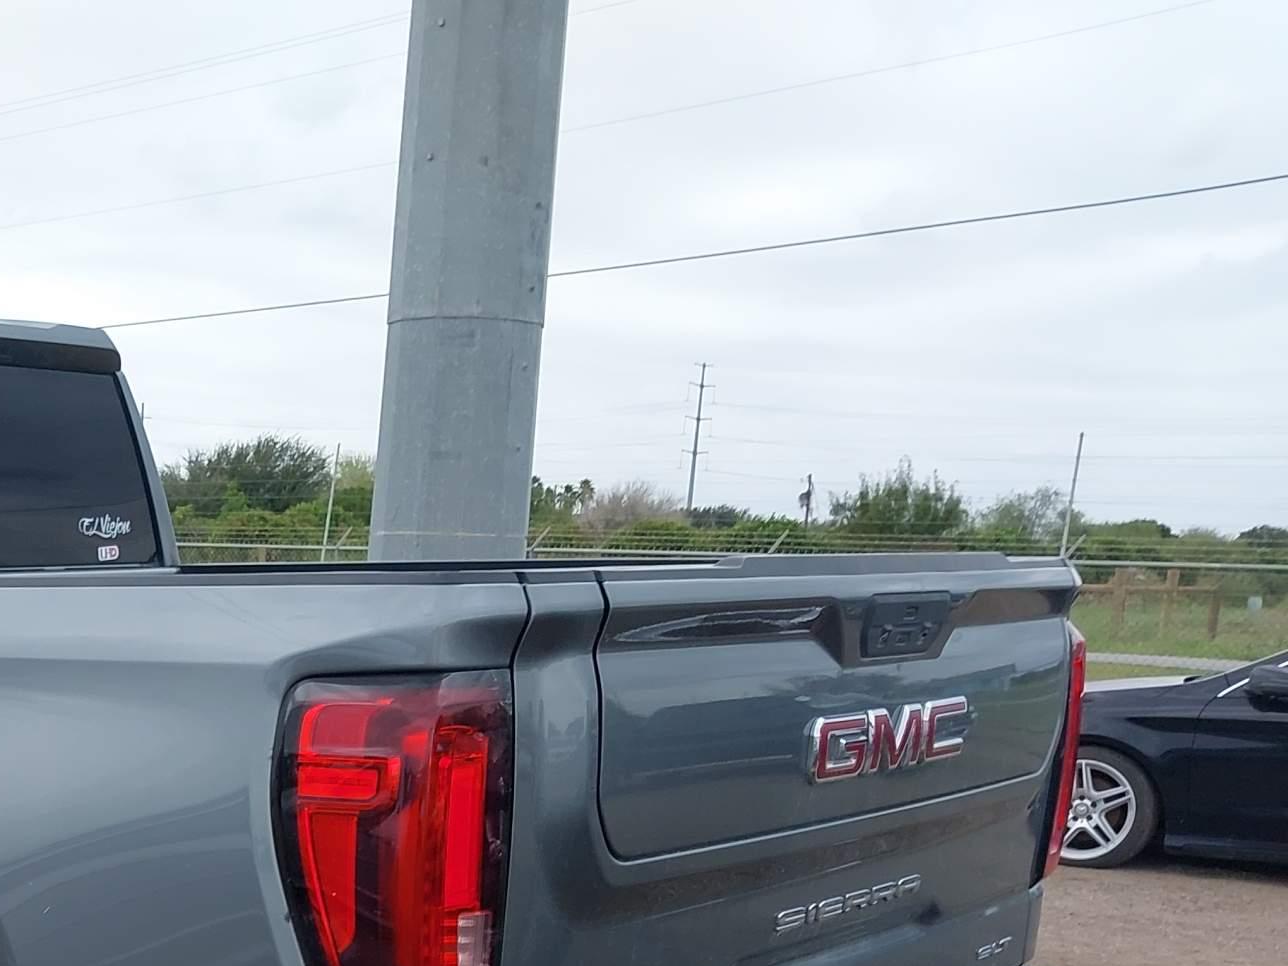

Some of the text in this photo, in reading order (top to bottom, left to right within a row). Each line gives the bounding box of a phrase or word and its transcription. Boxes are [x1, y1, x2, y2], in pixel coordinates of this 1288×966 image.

[808, 695, 968, 784] GMC
[775, 873, 921, 933] SIERRA
[976, 936, 1013, 961] SLT
